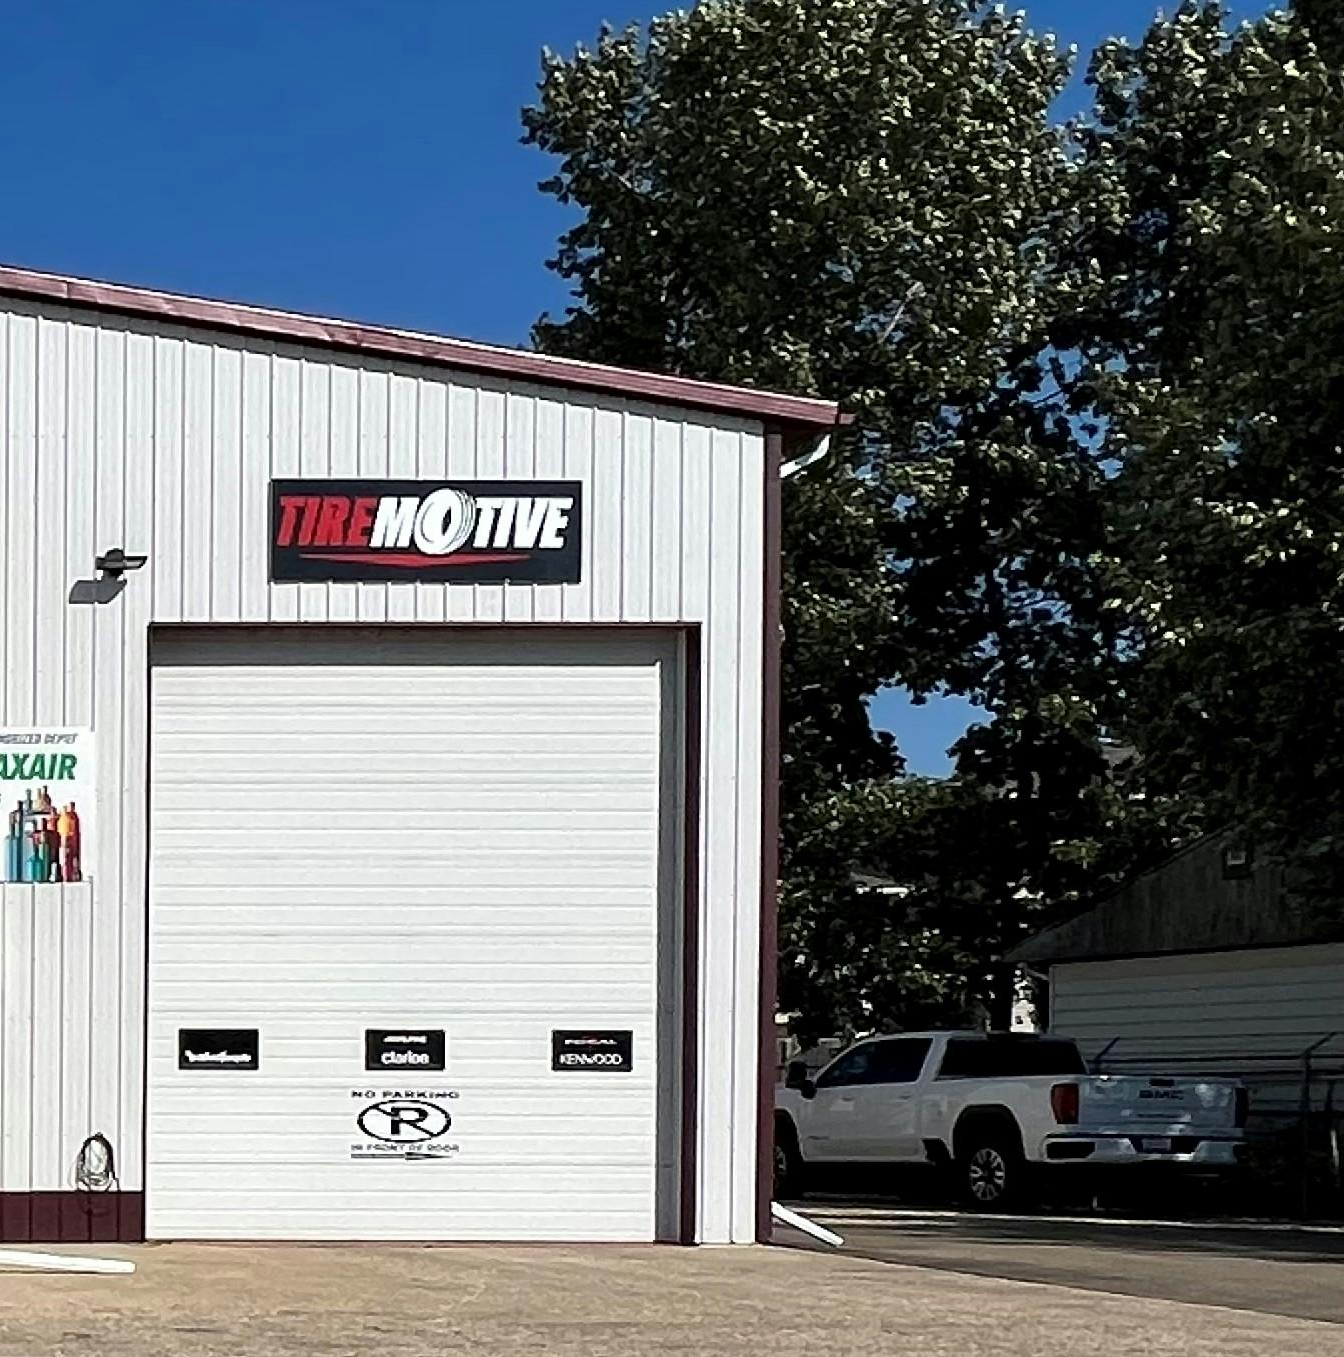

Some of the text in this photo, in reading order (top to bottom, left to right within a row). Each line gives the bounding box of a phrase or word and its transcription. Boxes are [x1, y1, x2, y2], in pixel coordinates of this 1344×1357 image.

[559, 1053, 624, 1065] KENWOOD
[351, 1090, 460, 1099] NO PARKING
